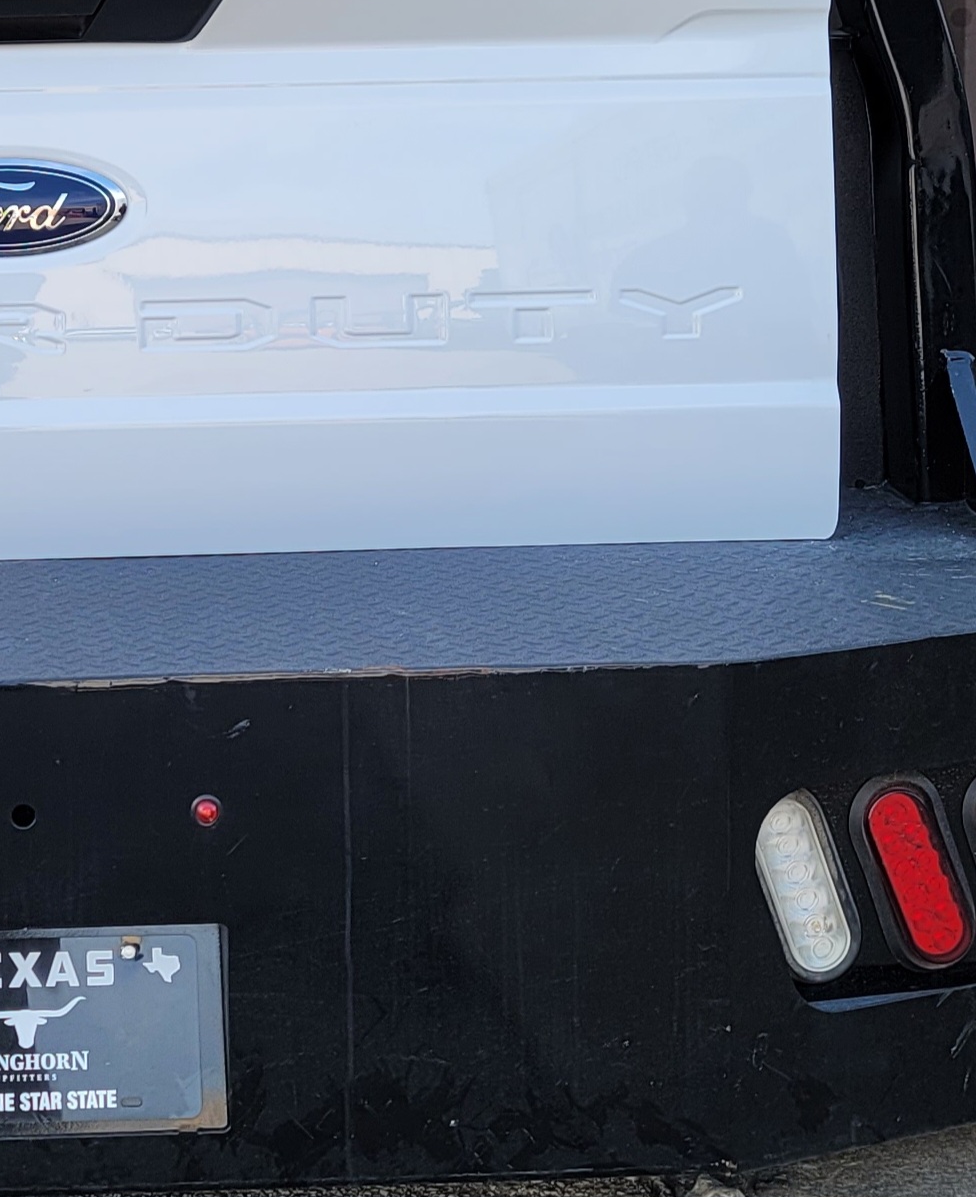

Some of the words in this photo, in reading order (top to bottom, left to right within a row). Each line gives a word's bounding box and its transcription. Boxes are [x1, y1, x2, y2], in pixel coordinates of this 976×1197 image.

[137, 286, 744, 353] DUTY
[18, 1091, 63, 1112] STAR
[66, 1089, 118, 1110] STATE
